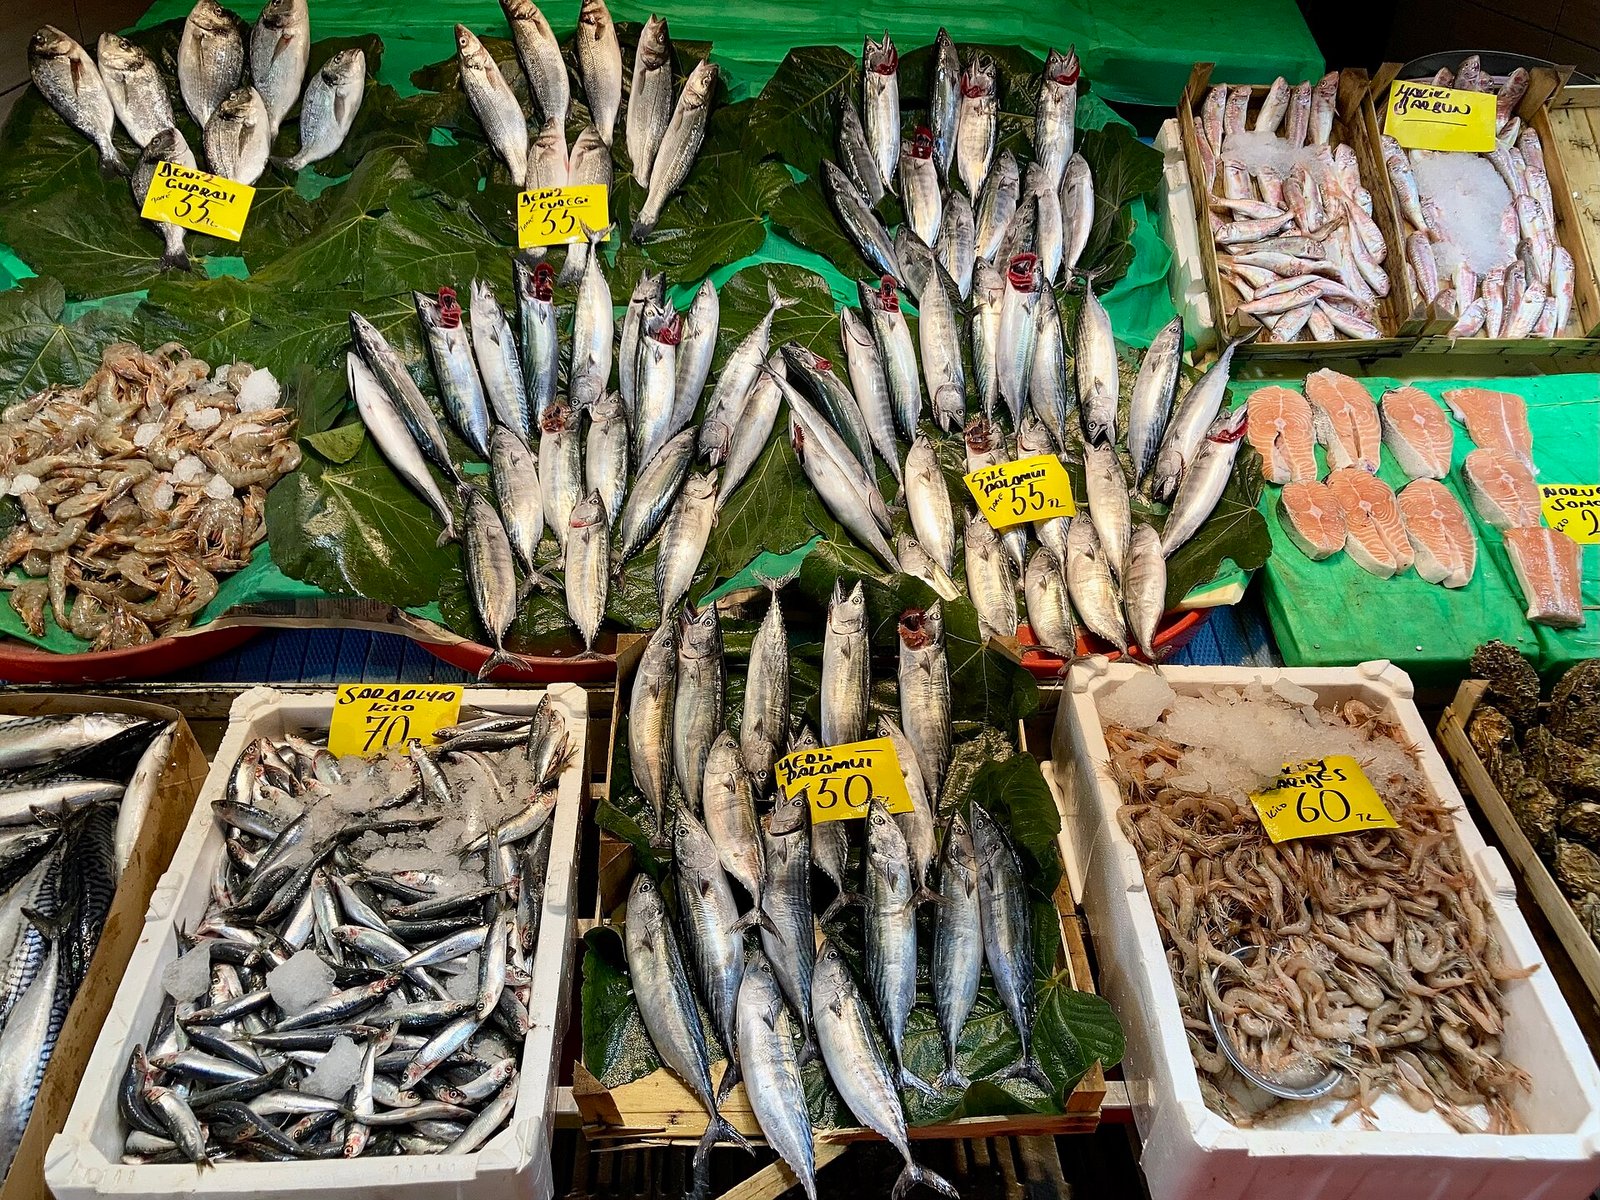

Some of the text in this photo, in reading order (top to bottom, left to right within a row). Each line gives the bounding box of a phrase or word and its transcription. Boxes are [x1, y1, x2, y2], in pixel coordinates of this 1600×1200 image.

[174, 193, 225, 224] 55
[541, 207, 588, 235] 55
[1011, 479, 1046, 516] 55
[363, 715, 410, 752] 70
[816, 774, 873, 808] 50
[1296, 790, 1351, 823] 60
[1356, 813, 1385, 822] TL
